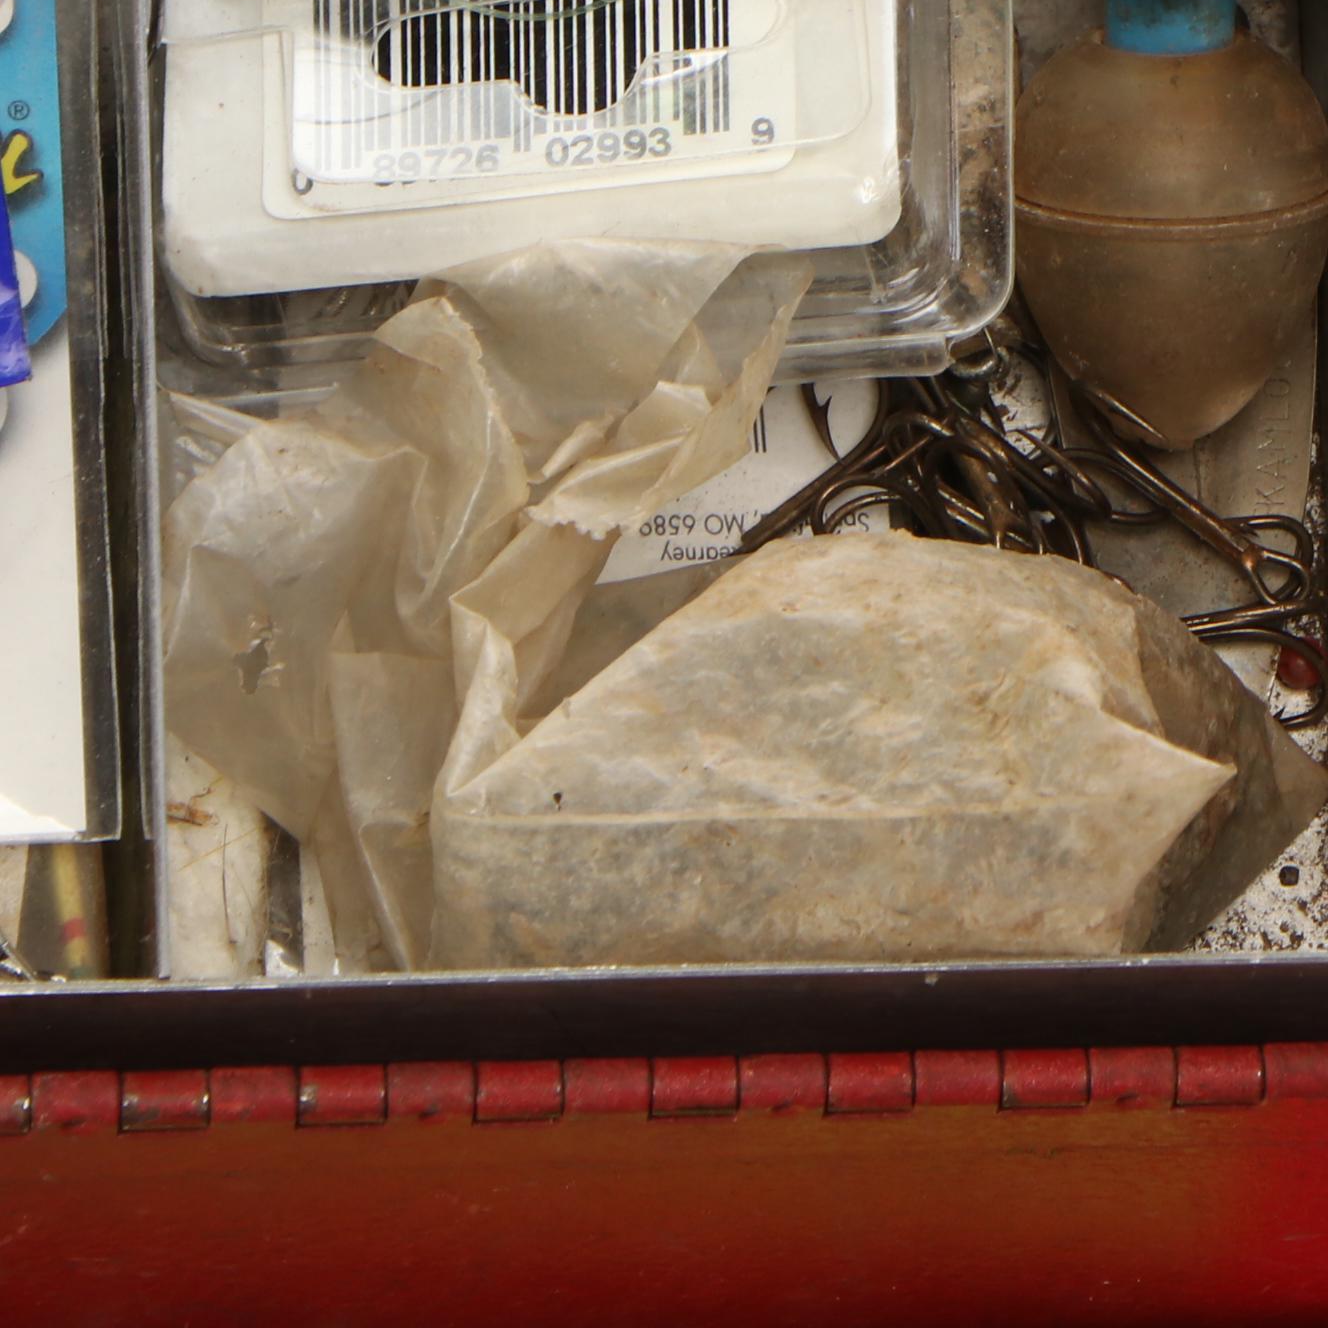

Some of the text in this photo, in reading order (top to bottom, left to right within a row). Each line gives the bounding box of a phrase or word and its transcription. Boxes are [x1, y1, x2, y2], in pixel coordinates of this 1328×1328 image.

[544, 126, 673, 169] 02993
[750, 116, 776, 152] 9
[704, 513, 745, 535] MO
